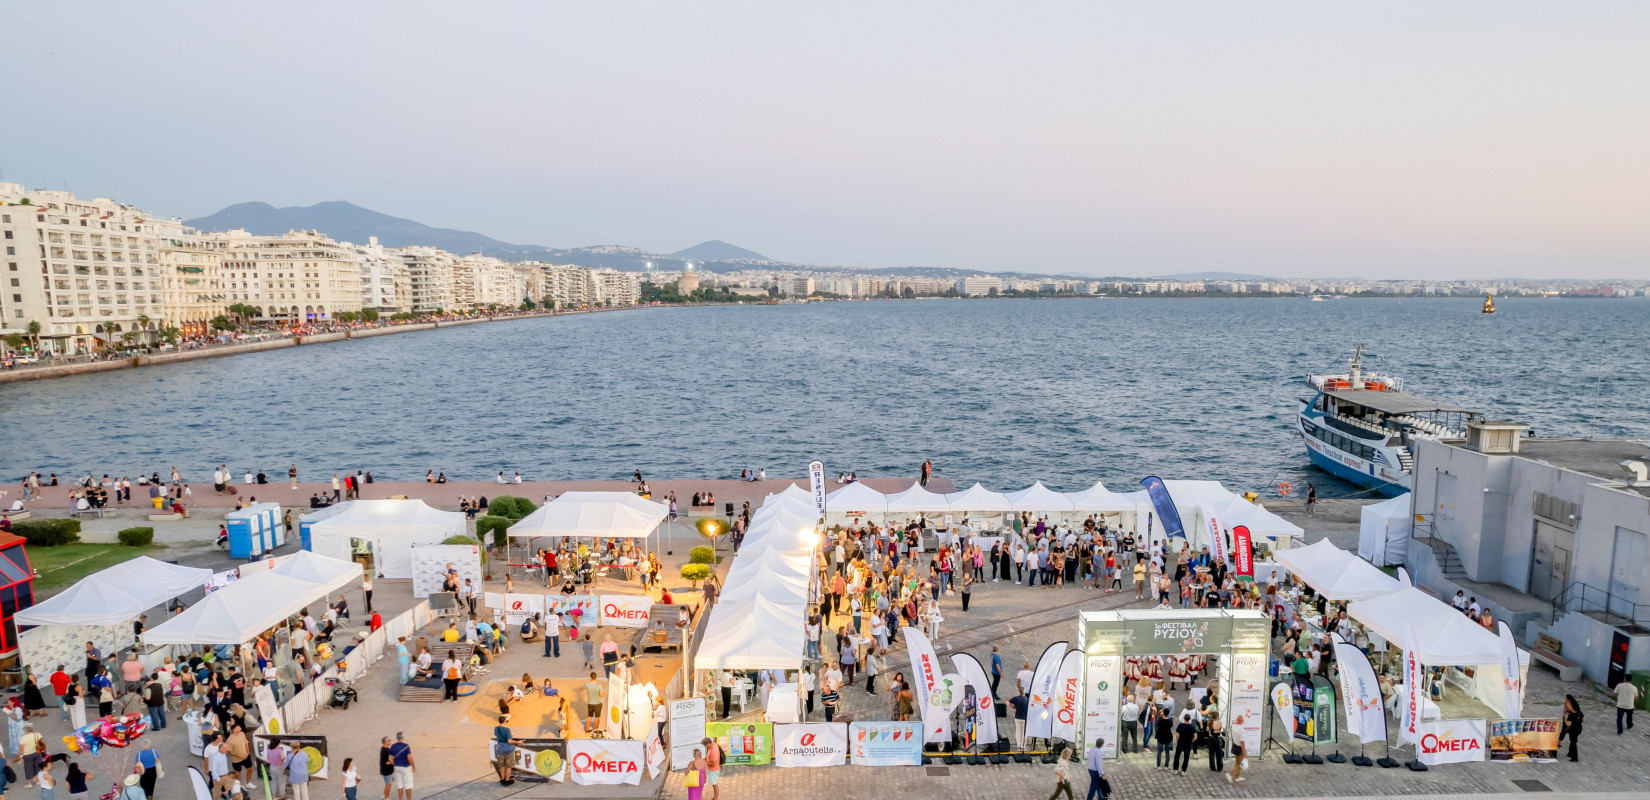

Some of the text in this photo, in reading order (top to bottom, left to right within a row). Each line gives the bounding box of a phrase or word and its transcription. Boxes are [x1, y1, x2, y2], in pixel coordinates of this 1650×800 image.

[1343, 456, 1361, 470] express
[604, 603, 649, 620] ΩΜΕΓΑ
[1057, 678, 1077, 725] ΩΜΕΓΑ
[783, 746, 834, 755] Arnaoutelis
[1421, 733, 1480, 753] ΩΜΕΓΑ
[573, 752, 638, 773] ΩΜΕΓΑ
